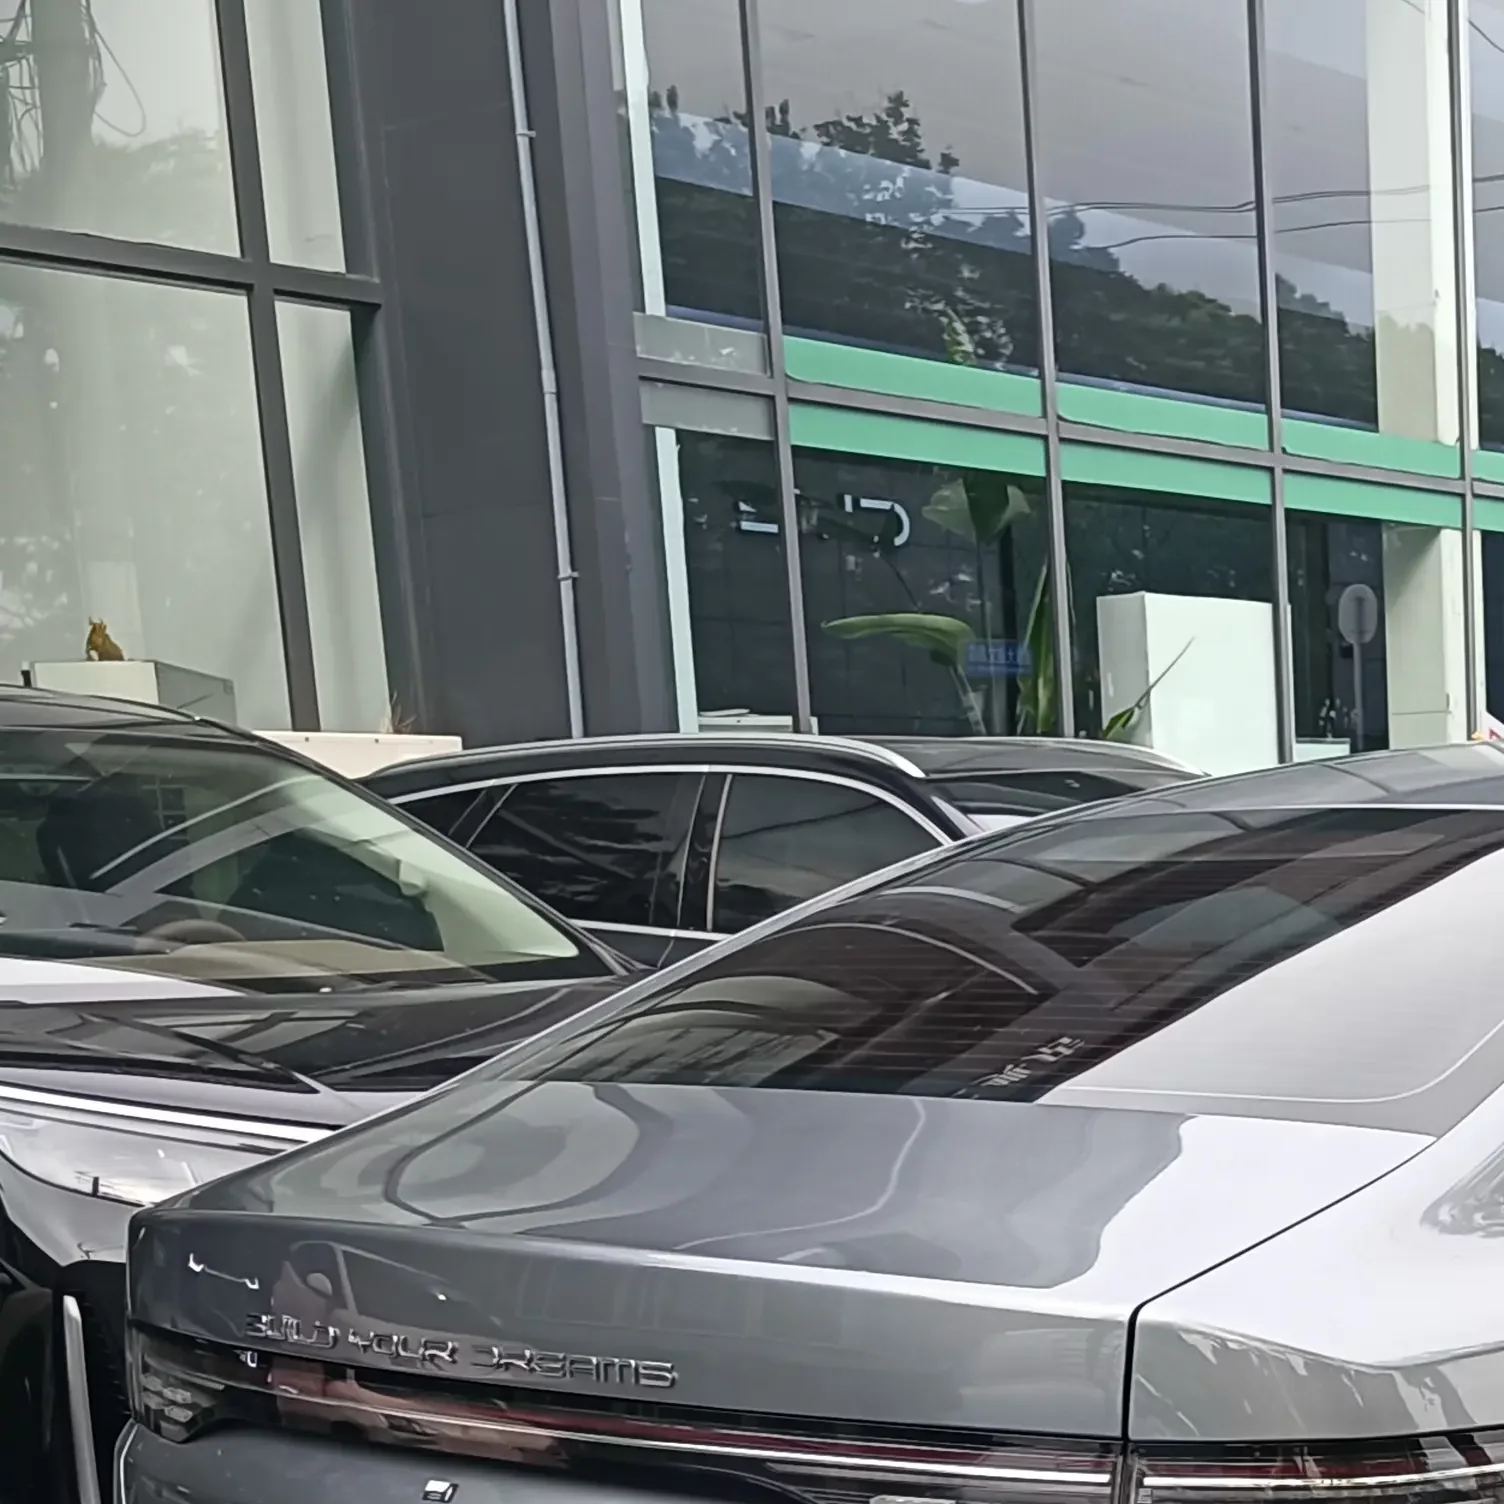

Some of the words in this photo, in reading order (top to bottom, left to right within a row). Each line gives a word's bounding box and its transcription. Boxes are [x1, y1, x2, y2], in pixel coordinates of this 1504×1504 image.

[245, 1312, 340, 1350] BUILD
[348, 1326, 459, 1367] YOUR
[471, 1344, 679, 1389] DREAMS
